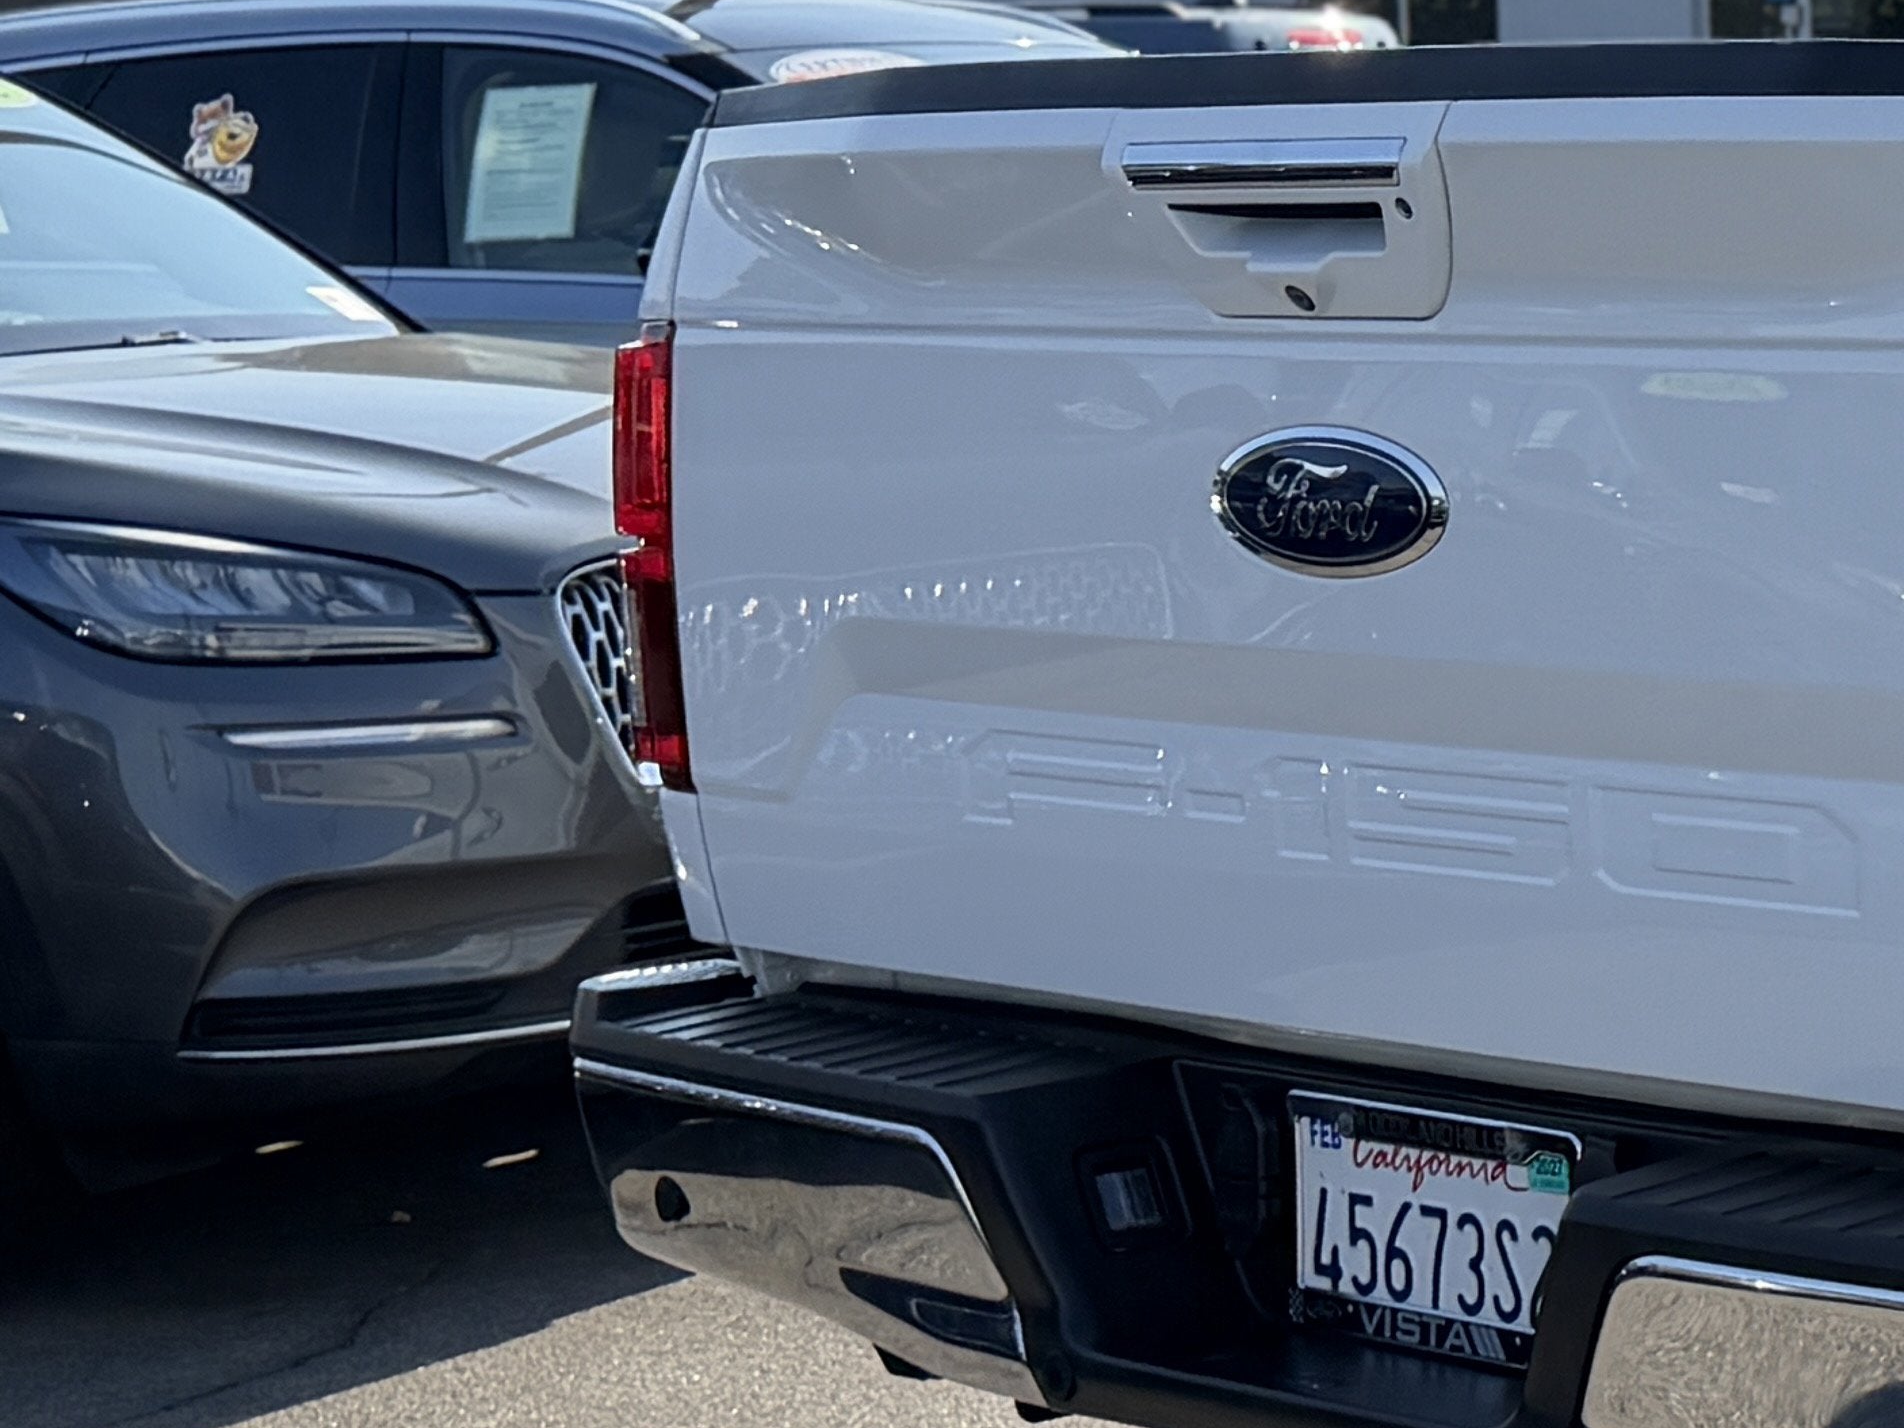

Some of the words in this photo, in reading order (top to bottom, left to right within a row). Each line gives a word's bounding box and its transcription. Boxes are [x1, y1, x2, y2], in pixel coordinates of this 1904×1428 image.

[1256, 457, 1380, 542] Ford
[961, 729, 1860, 918] F-150
[1352, 1139, 1528, 1193] California
[1360, 1306, 1472, 1355] VISTA
